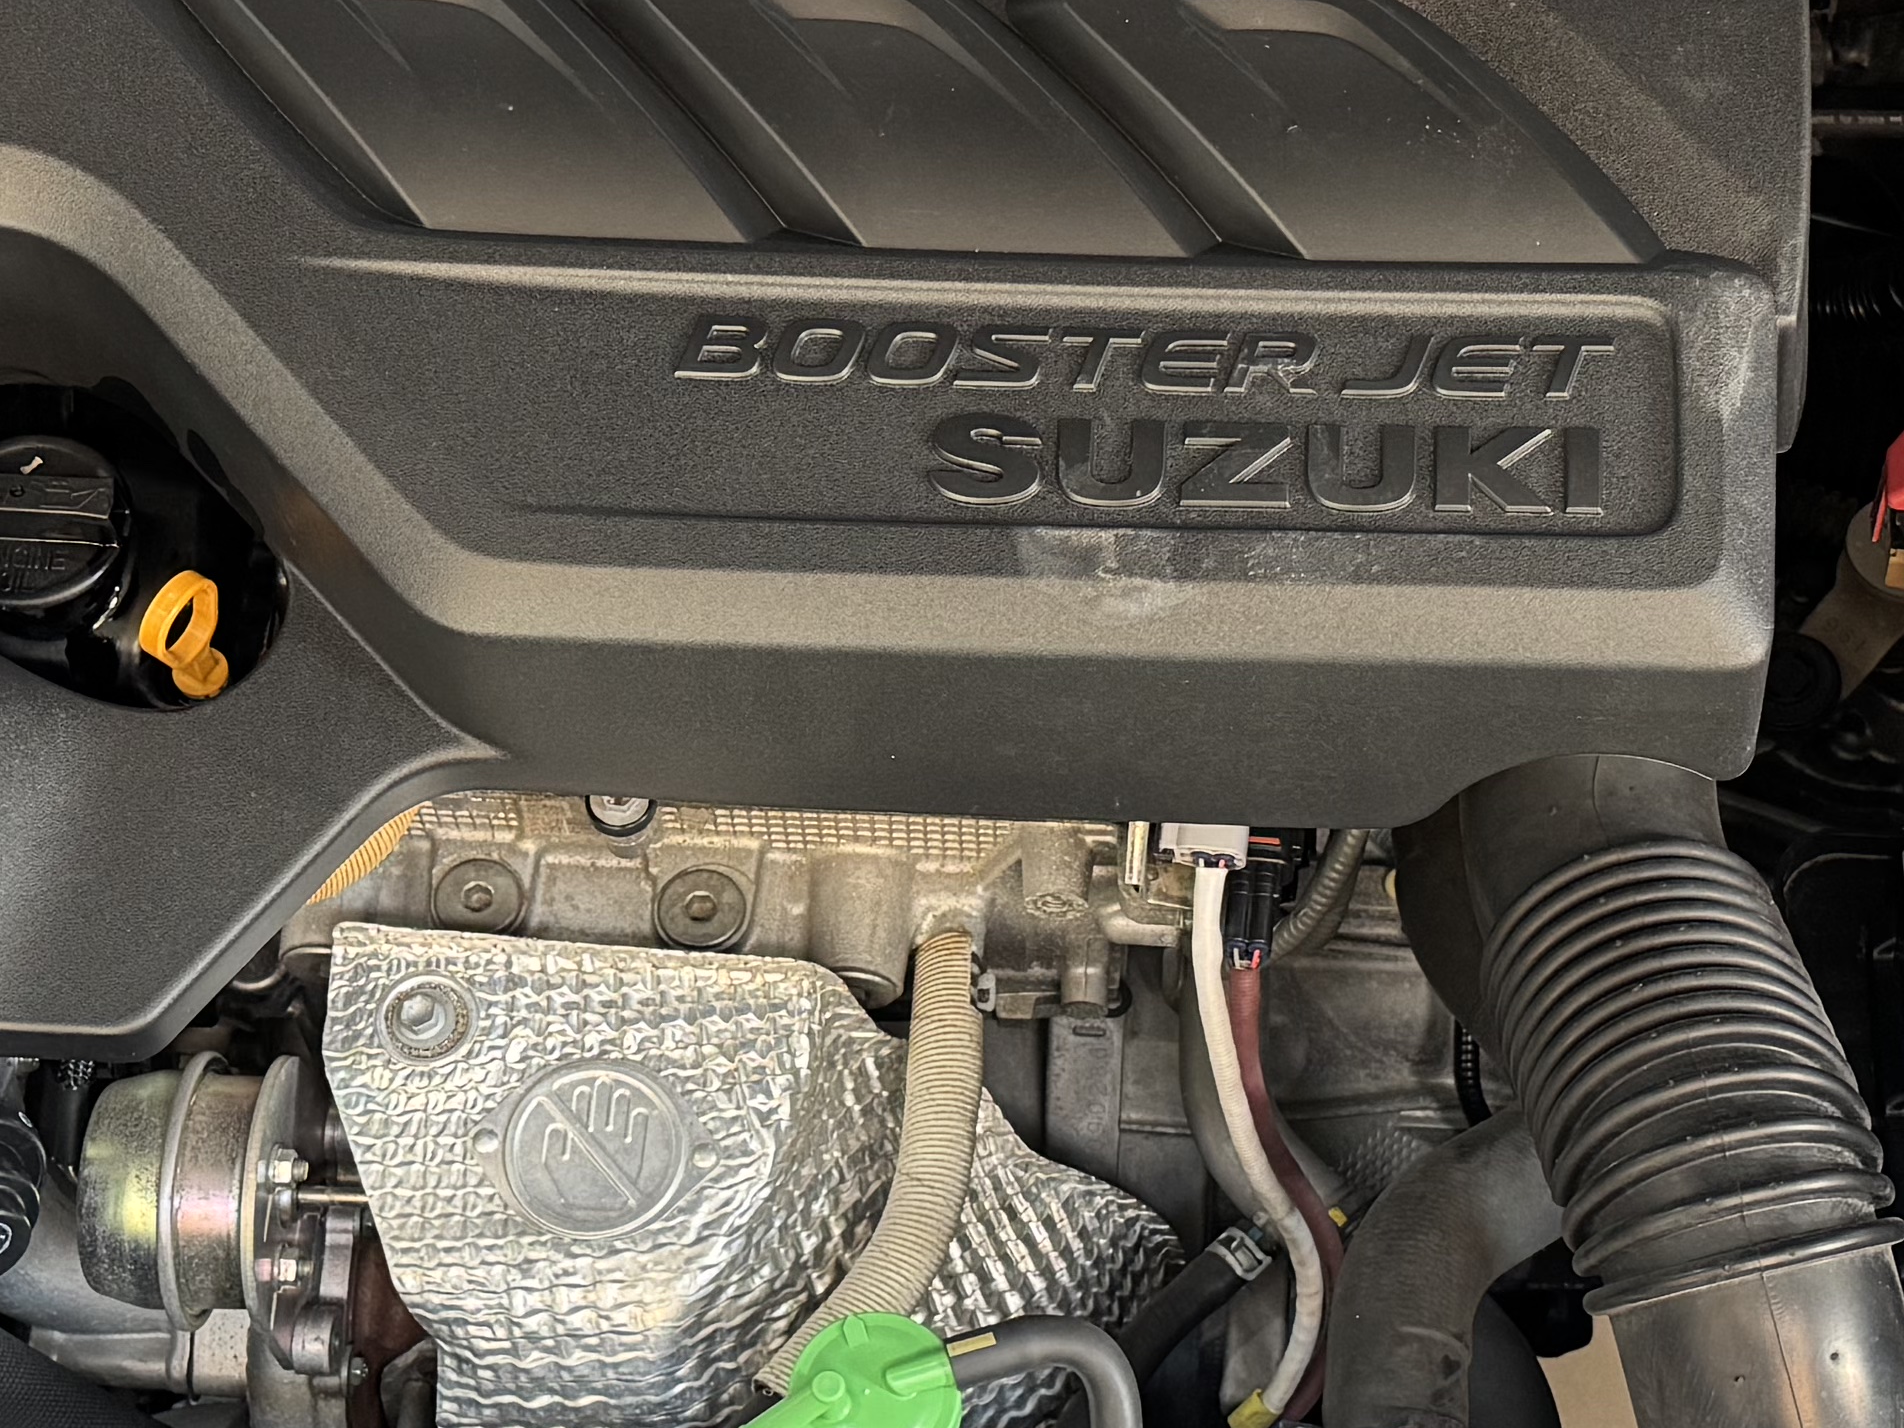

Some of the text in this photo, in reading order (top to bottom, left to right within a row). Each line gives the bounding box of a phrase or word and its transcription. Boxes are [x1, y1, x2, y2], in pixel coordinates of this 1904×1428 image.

[673, 312, 1618, 401] BOOSTER JET
[927, 409, 1604, 517] SUZUKI
